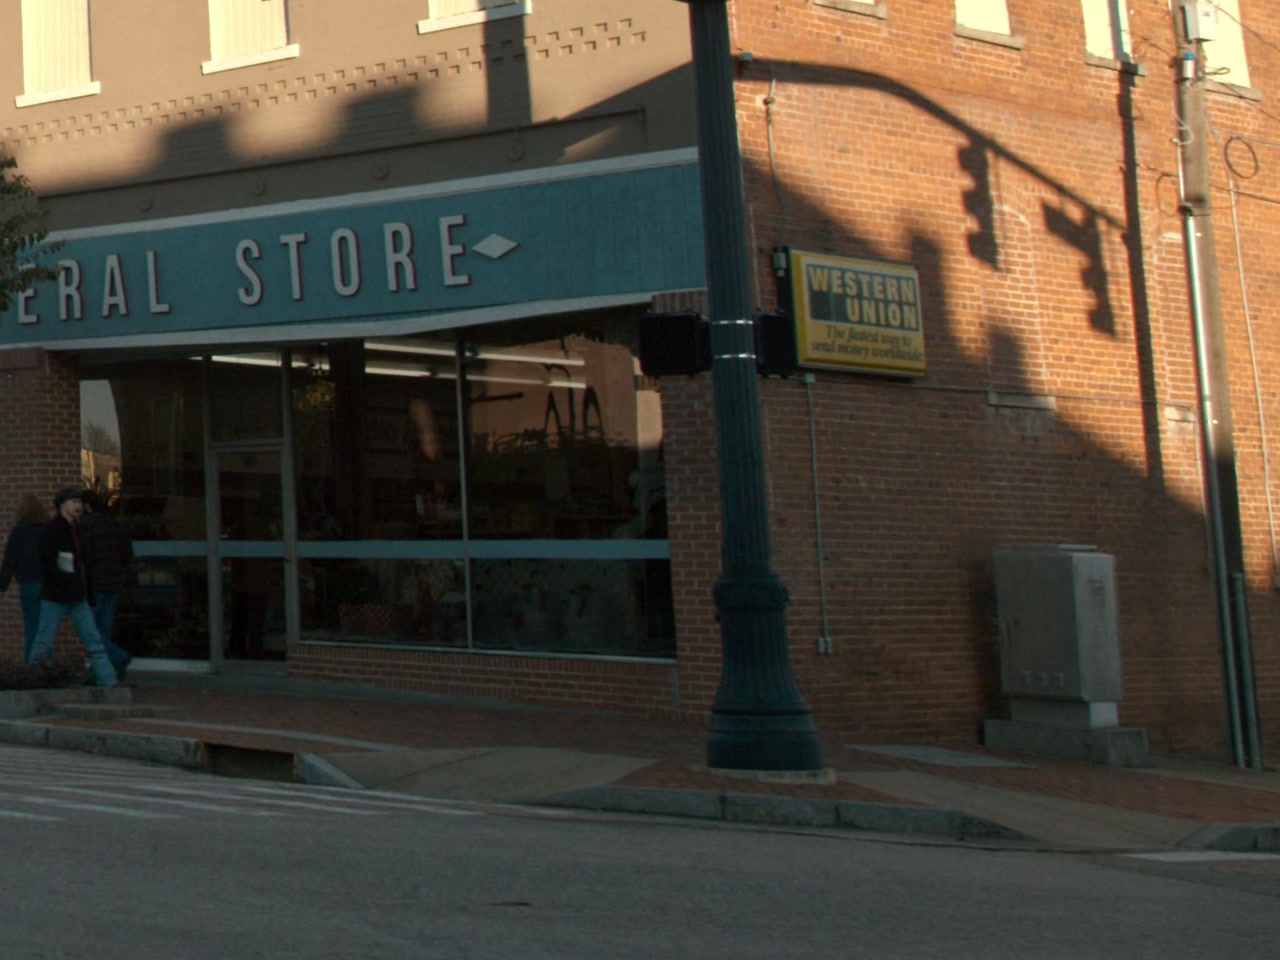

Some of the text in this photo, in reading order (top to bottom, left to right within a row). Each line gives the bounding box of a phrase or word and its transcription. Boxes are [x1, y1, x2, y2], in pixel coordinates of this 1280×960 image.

[235, 214, 471, 306] STORE
[808, 267, 915, 303] WESTERN
[846, 299, 917, 329] UNION
[811, 341, 836, 352] send
[837, 343, 868, 360] money
[827, 325, 912, 346] The fastest way to
